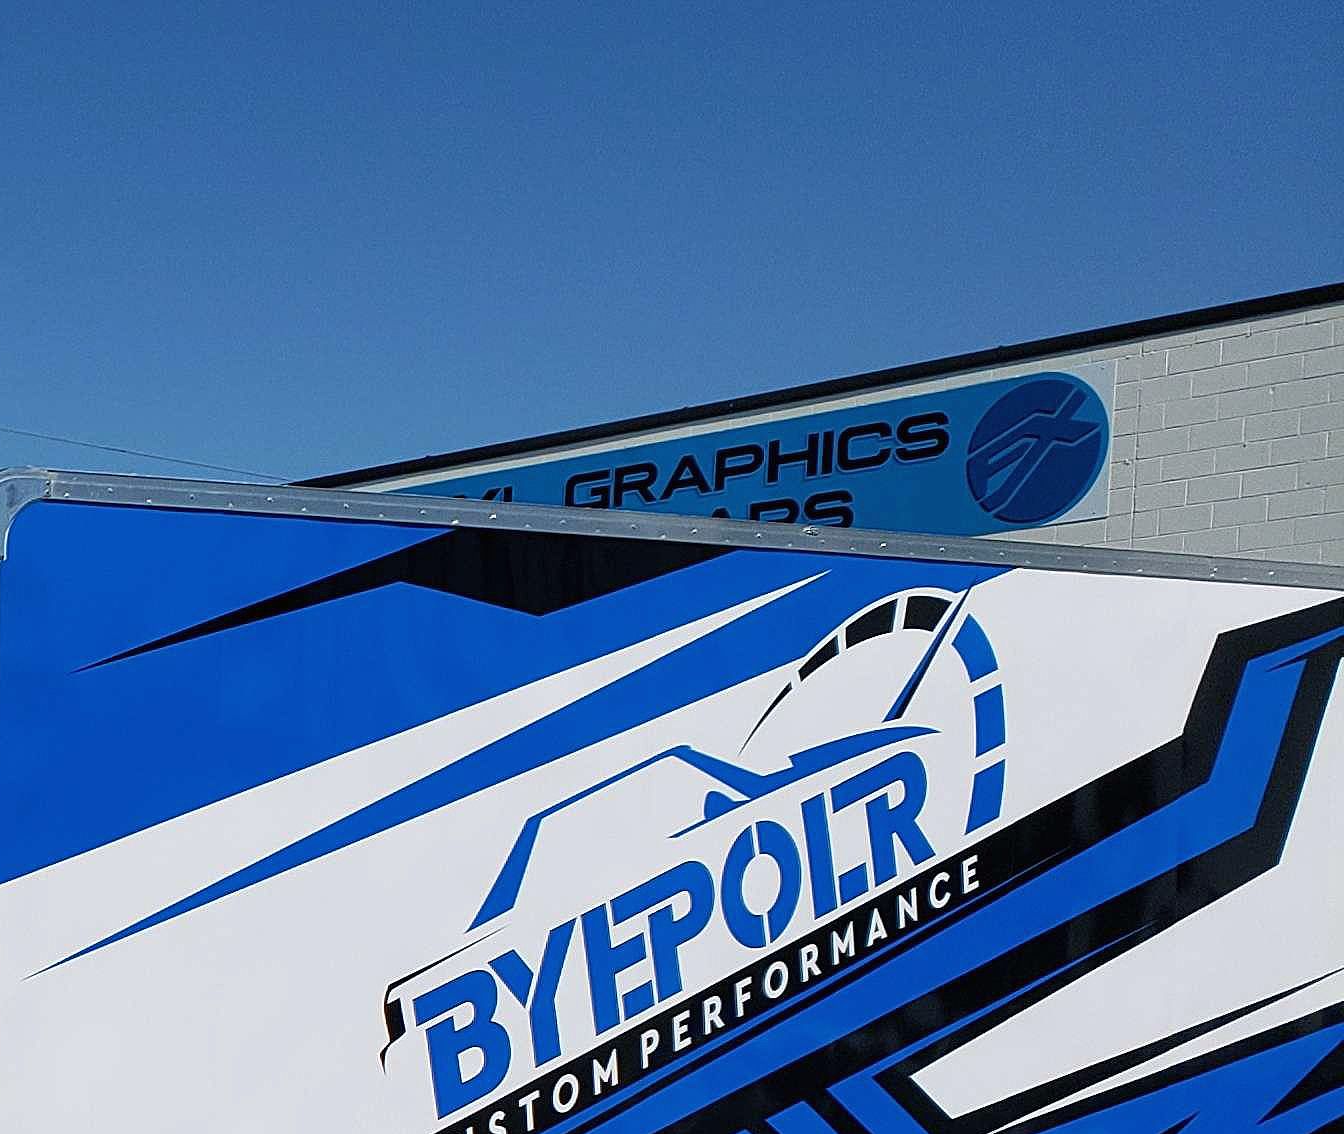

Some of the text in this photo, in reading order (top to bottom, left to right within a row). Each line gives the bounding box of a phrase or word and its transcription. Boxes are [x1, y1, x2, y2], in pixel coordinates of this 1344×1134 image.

[564, 411, 951, 509] GRAPHICS
[413, 752, 935, 1117] BYEPOLR
[640, 854, 980, 1069] PERFORMANCE
